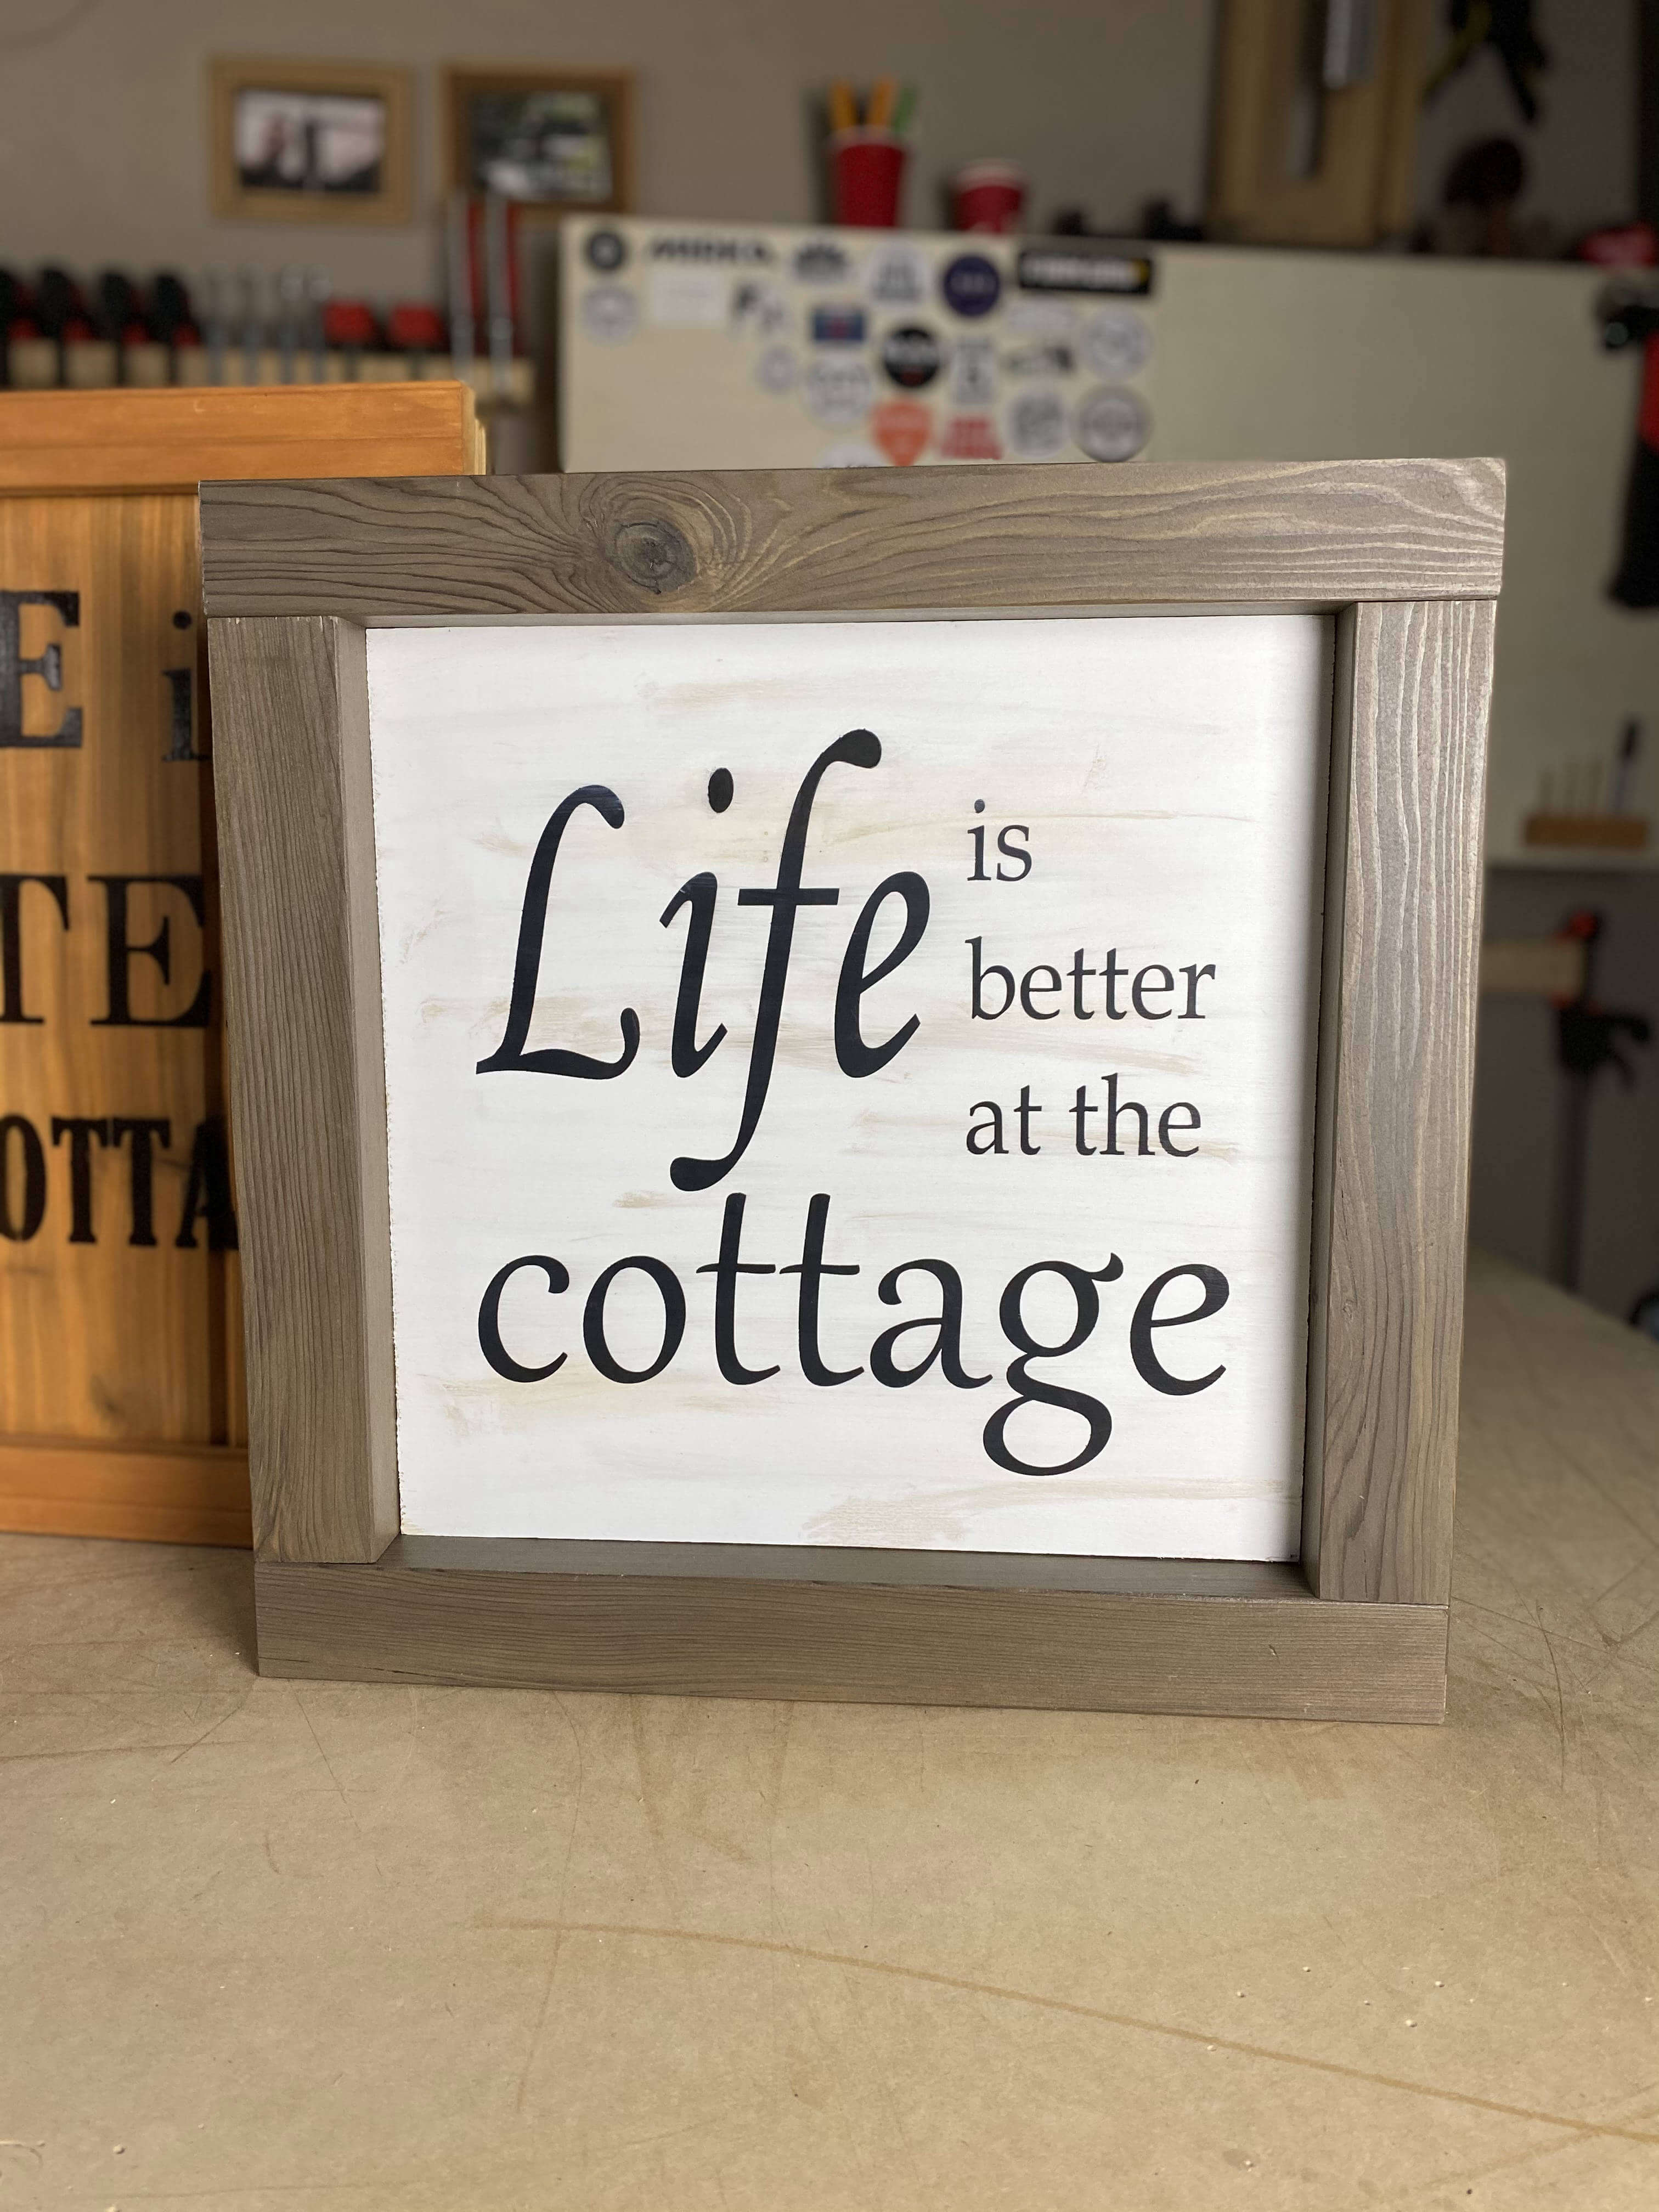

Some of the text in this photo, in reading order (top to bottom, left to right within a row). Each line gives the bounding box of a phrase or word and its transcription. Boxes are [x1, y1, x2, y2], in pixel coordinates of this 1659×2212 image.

[967, 799, 1032, 882] is
[475, 728, 930, 1192] Life
[964, 935, 1216, 1020] better
[966, 1072, 1201, 1158] at the
[477, 1192, 1230, 1477] cottage
